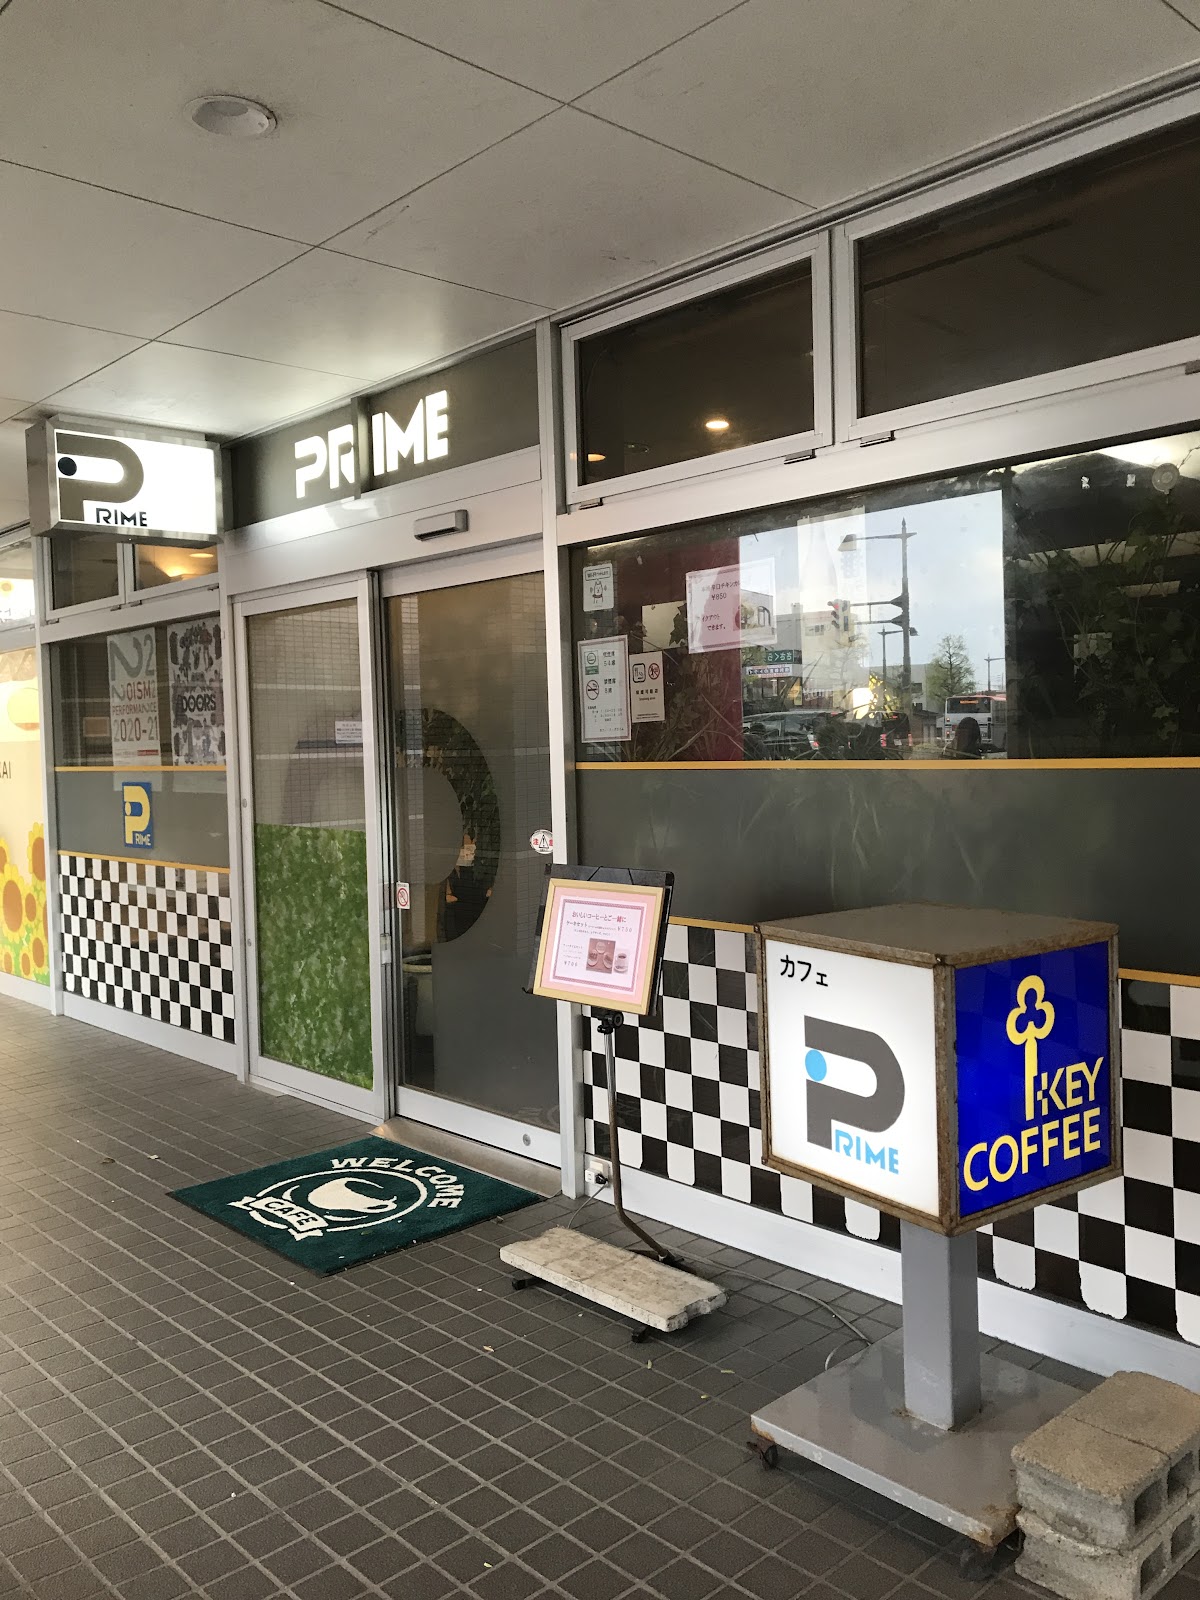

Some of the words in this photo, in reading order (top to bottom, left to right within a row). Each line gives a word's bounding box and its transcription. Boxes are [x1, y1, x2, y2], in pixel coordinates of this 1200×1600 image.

[294, 389, 449, 499] PRIME
[179, 693, 217, 713] DOORS
[113, 716, 159, 742] 2020-21
[571, 911, 627, 923] おいしいコーヒーとご一緒に
[780, 955, 829, 987] カフェ
[1037, 1057, 1104, 1116] KEY
[963, 1107, 1101, 1191] COFFEE
[330, 1156, 465, 1209] WELCOME
[262, 1200, 317, 1230] CAFE
